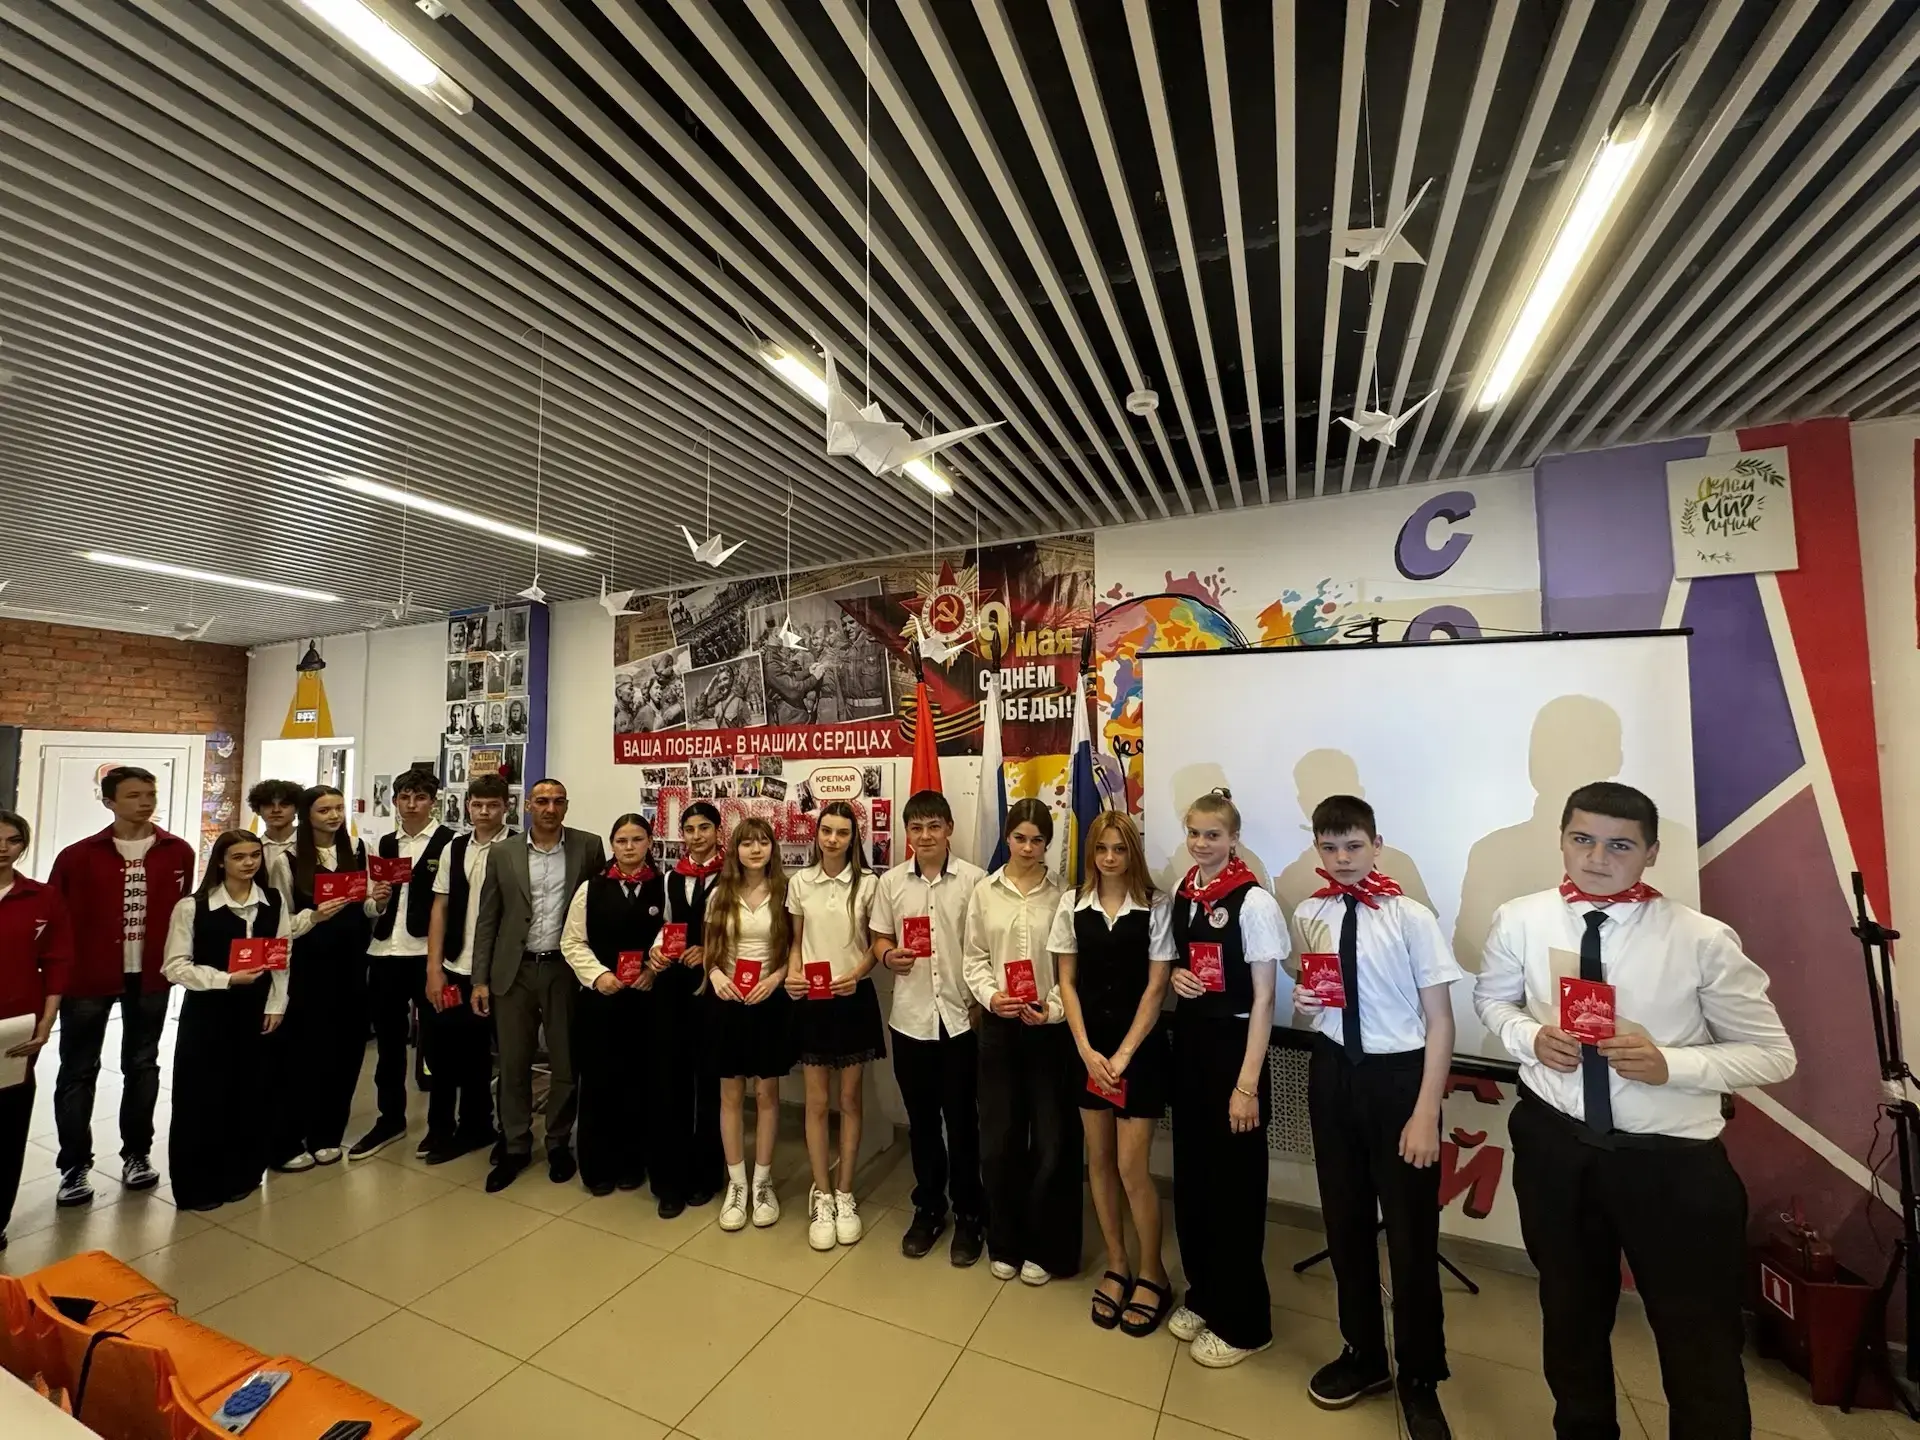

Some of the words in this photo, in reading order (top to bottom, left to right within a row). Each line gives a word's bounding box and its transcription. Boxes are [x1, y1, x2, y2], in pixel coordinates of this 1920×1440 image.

[978, 601, 1010, 660] 9
[1015, 627, 1073, 657] мая
[979, 669, 992, 691] С
[999, 662, 1055, 692] ДНЁМ
[980, 696, 1072, 722] ПБЕДЫ!
[623, 739, 662, 758] ВАША
[665, 736, 722, 758] ПОБЕДА
[737, 735, 747, 753] В
[750, 732, 808, 753] НАШИХ
[812, 729, 893, 755] СЕРДЦАХ
[815, 774, 856, 783] КРЕПКАЯ
[820, 785, 851, 793] СЕМЬЯ
